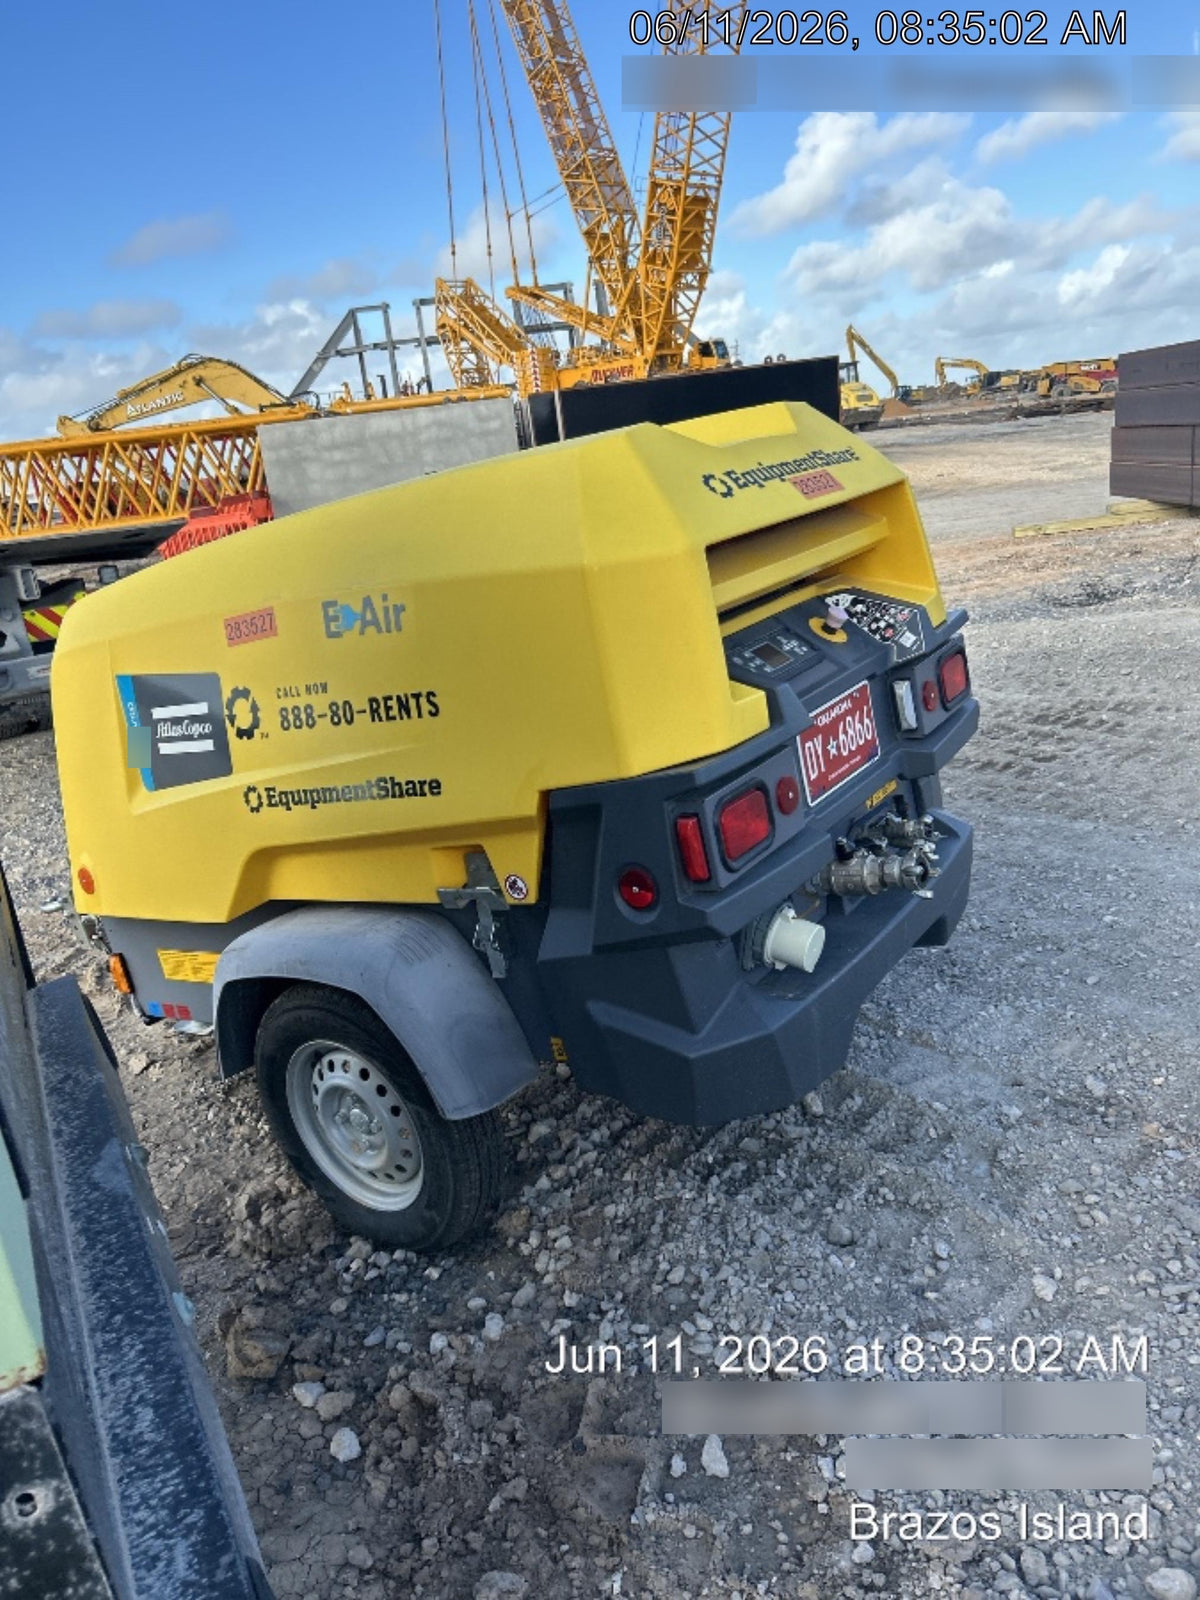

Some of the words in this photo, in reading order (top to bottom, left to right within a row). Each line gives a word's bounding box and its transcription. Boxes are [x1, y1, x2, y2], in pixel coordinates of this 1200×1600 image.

[126, 391, 184, 418] ATLANTIC
[723, 448, 860, 488] EquipmentShare
[226, 612, 275, 641] 283527
[276, 687, 301, 699] CALL
[305, 682, 328, 695] NOW
[279, 691, 440, 731] 888-80-RENTS
[804, 733, 826, 781] DY
[838, 705, 873, 757] 6866
[264, 776, 442, 811] EquipmentShare
